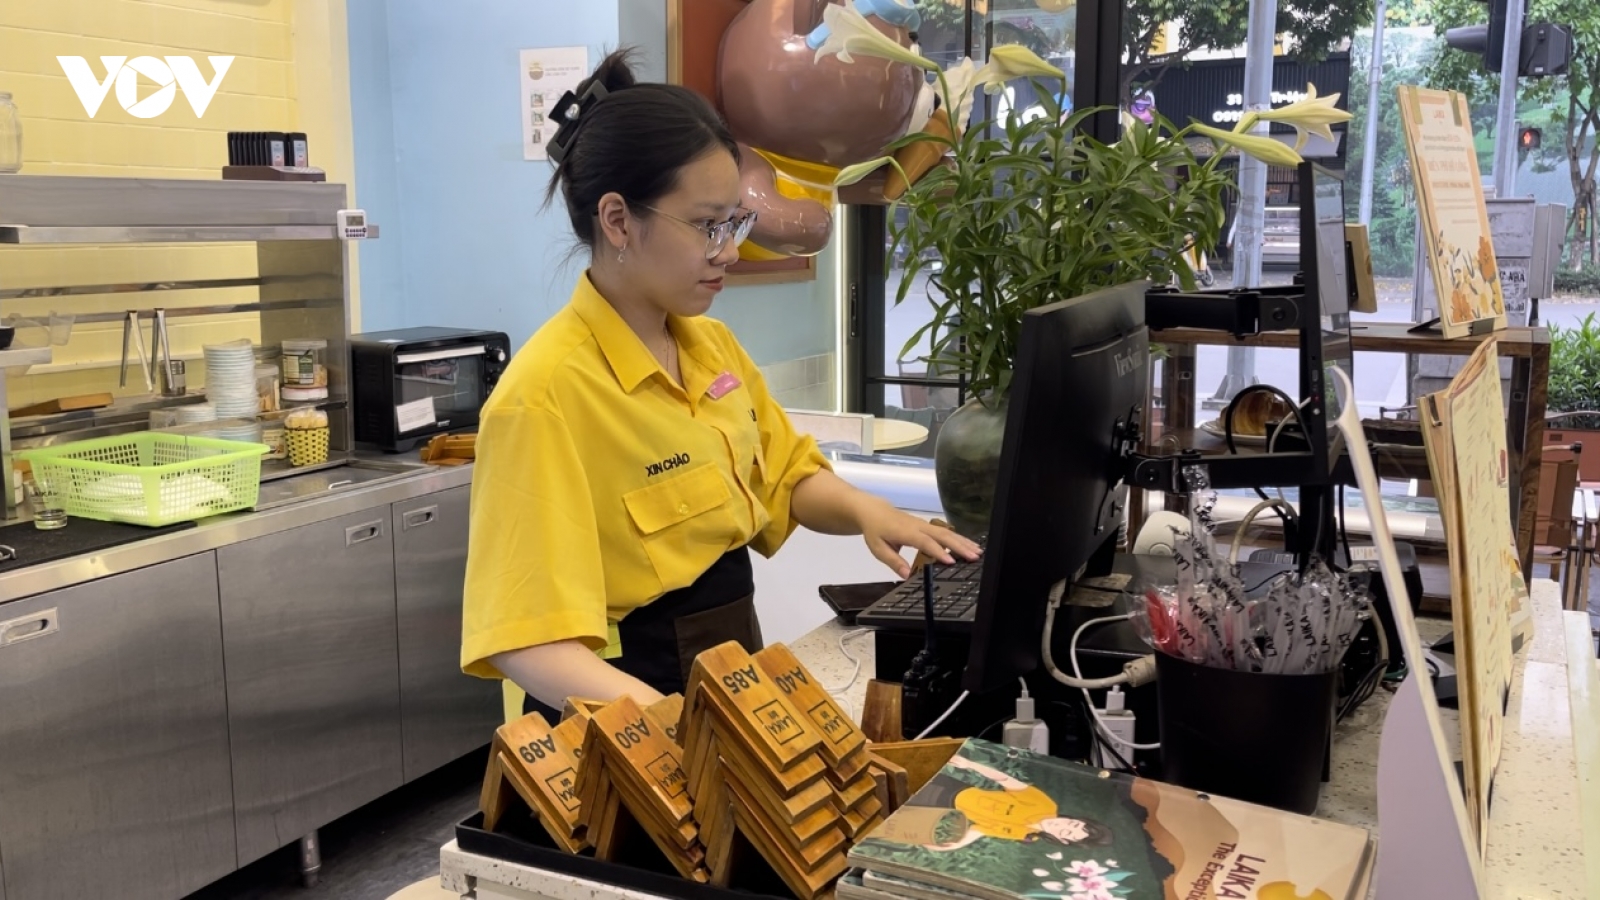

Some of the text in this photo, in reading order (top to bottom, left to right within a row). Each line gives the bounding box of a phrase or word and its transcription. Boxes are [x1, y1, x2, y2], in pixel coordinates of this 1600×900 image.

[645, 453, 691, 477] XIN CHÀO
[722, 664, 761, 695] A85
[775, 666, 809, 696] A40
[614, 717, 651, 750] A90
[768, 714, 796, 735] LAIKA
[519, 734, 556, 764] A89
[1212, 842, 1237, 860] The
[1215, 853, 1267, 900] LAIKA
